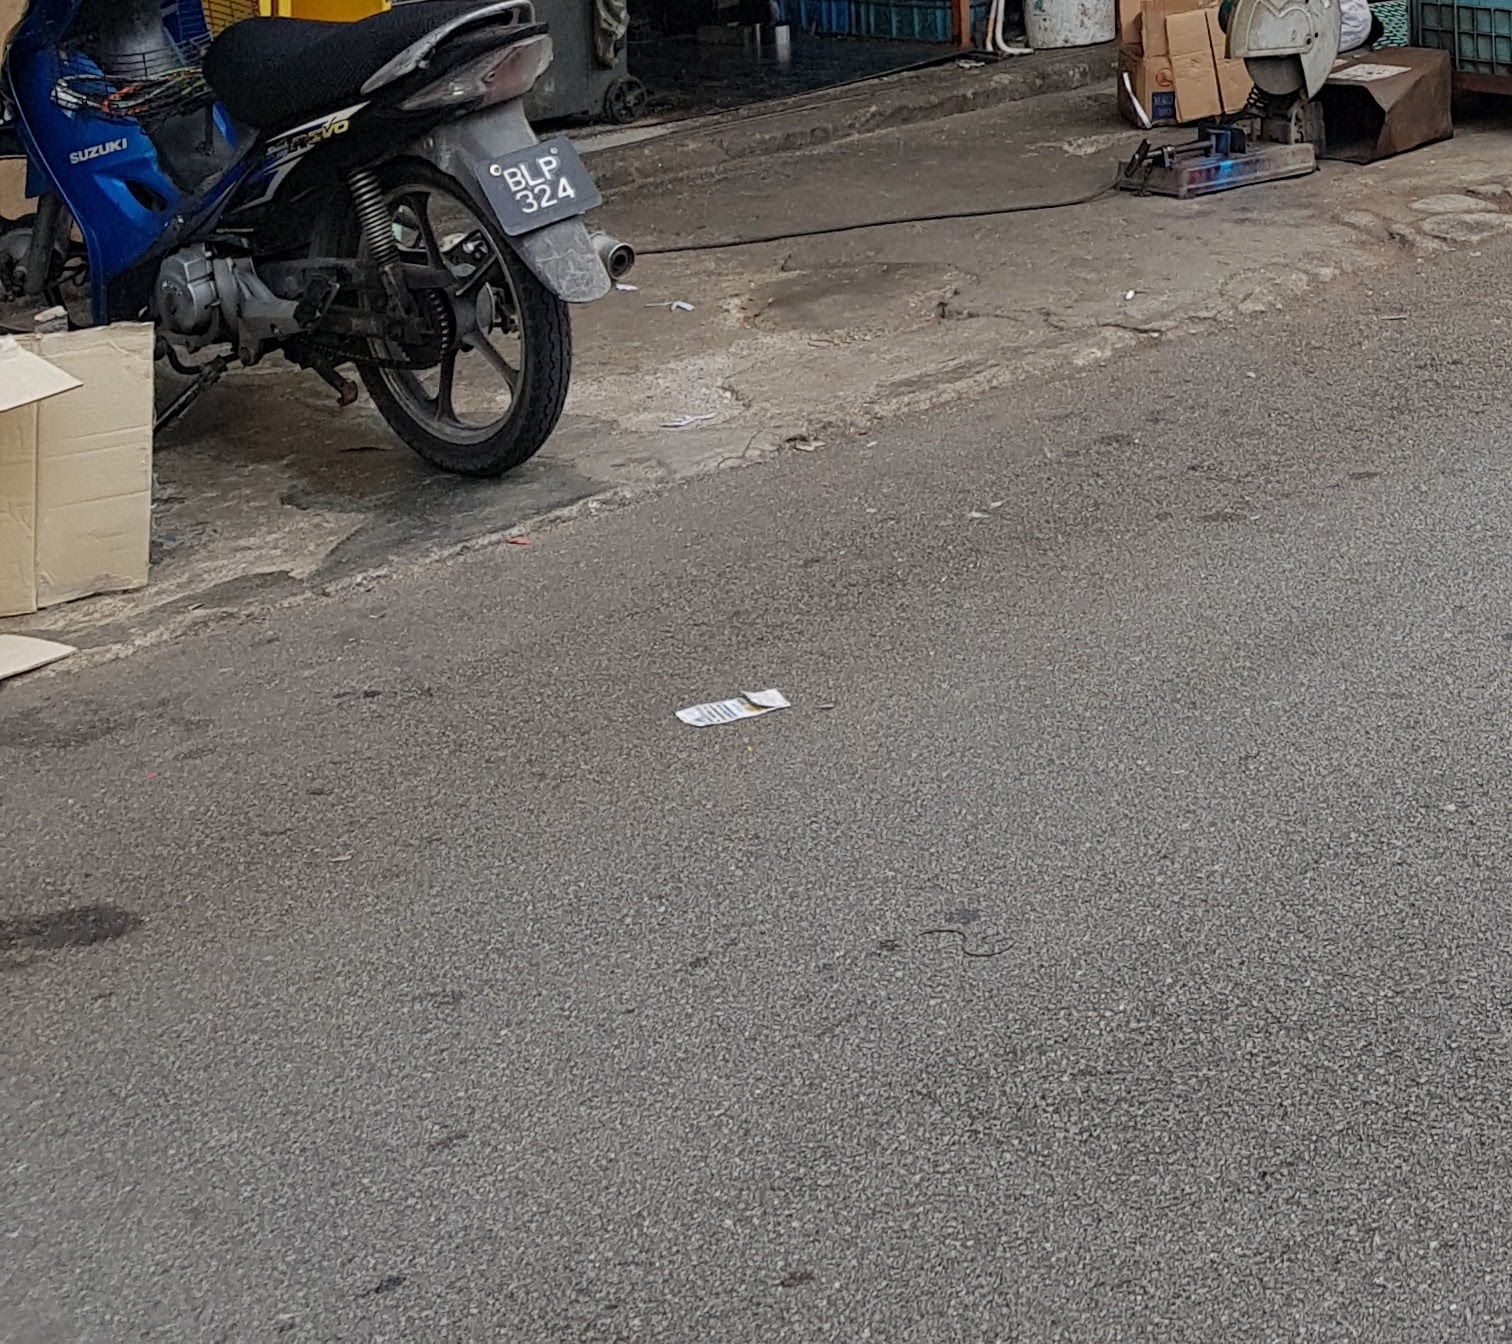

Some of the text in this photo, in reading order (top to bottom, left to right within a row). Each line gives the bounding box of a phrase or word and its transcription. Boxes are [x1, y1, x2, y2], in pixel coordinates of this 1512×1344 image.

[69, 137, 128, 165] SUZUKI
[503, 156, 559, 194] BLP
[519, 177, 576, 215] 324
